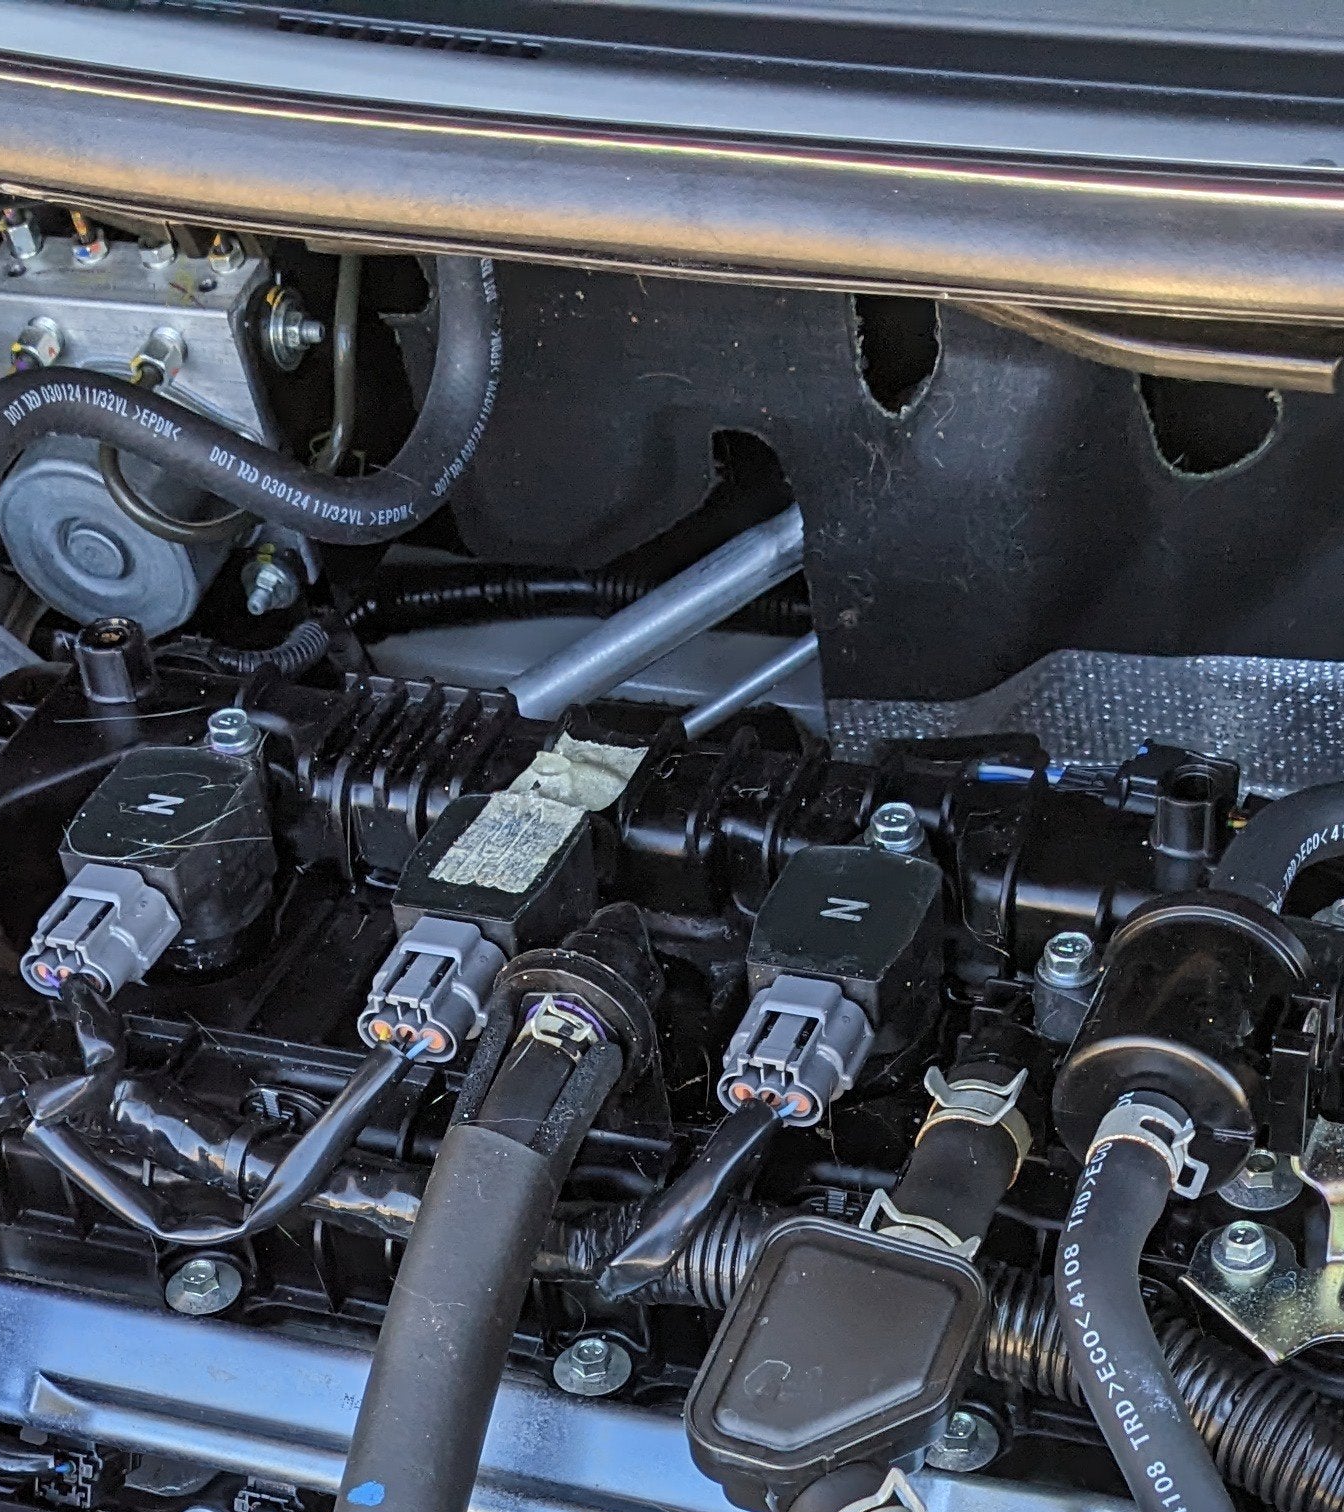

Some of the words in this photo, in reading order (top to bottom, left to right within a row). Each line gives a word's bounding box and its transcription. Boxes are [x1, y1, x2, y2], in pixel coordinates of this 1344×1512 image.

[3, 401, 26, 427] DOT
[40, 383, 81, 403] 030124
[132, 404, 184, 442] >EPDM<
[209, 446, 236, 471] DOT
[261, 475, 309, 511] 030124
[369, 502, 415, 526] >EPDM<
